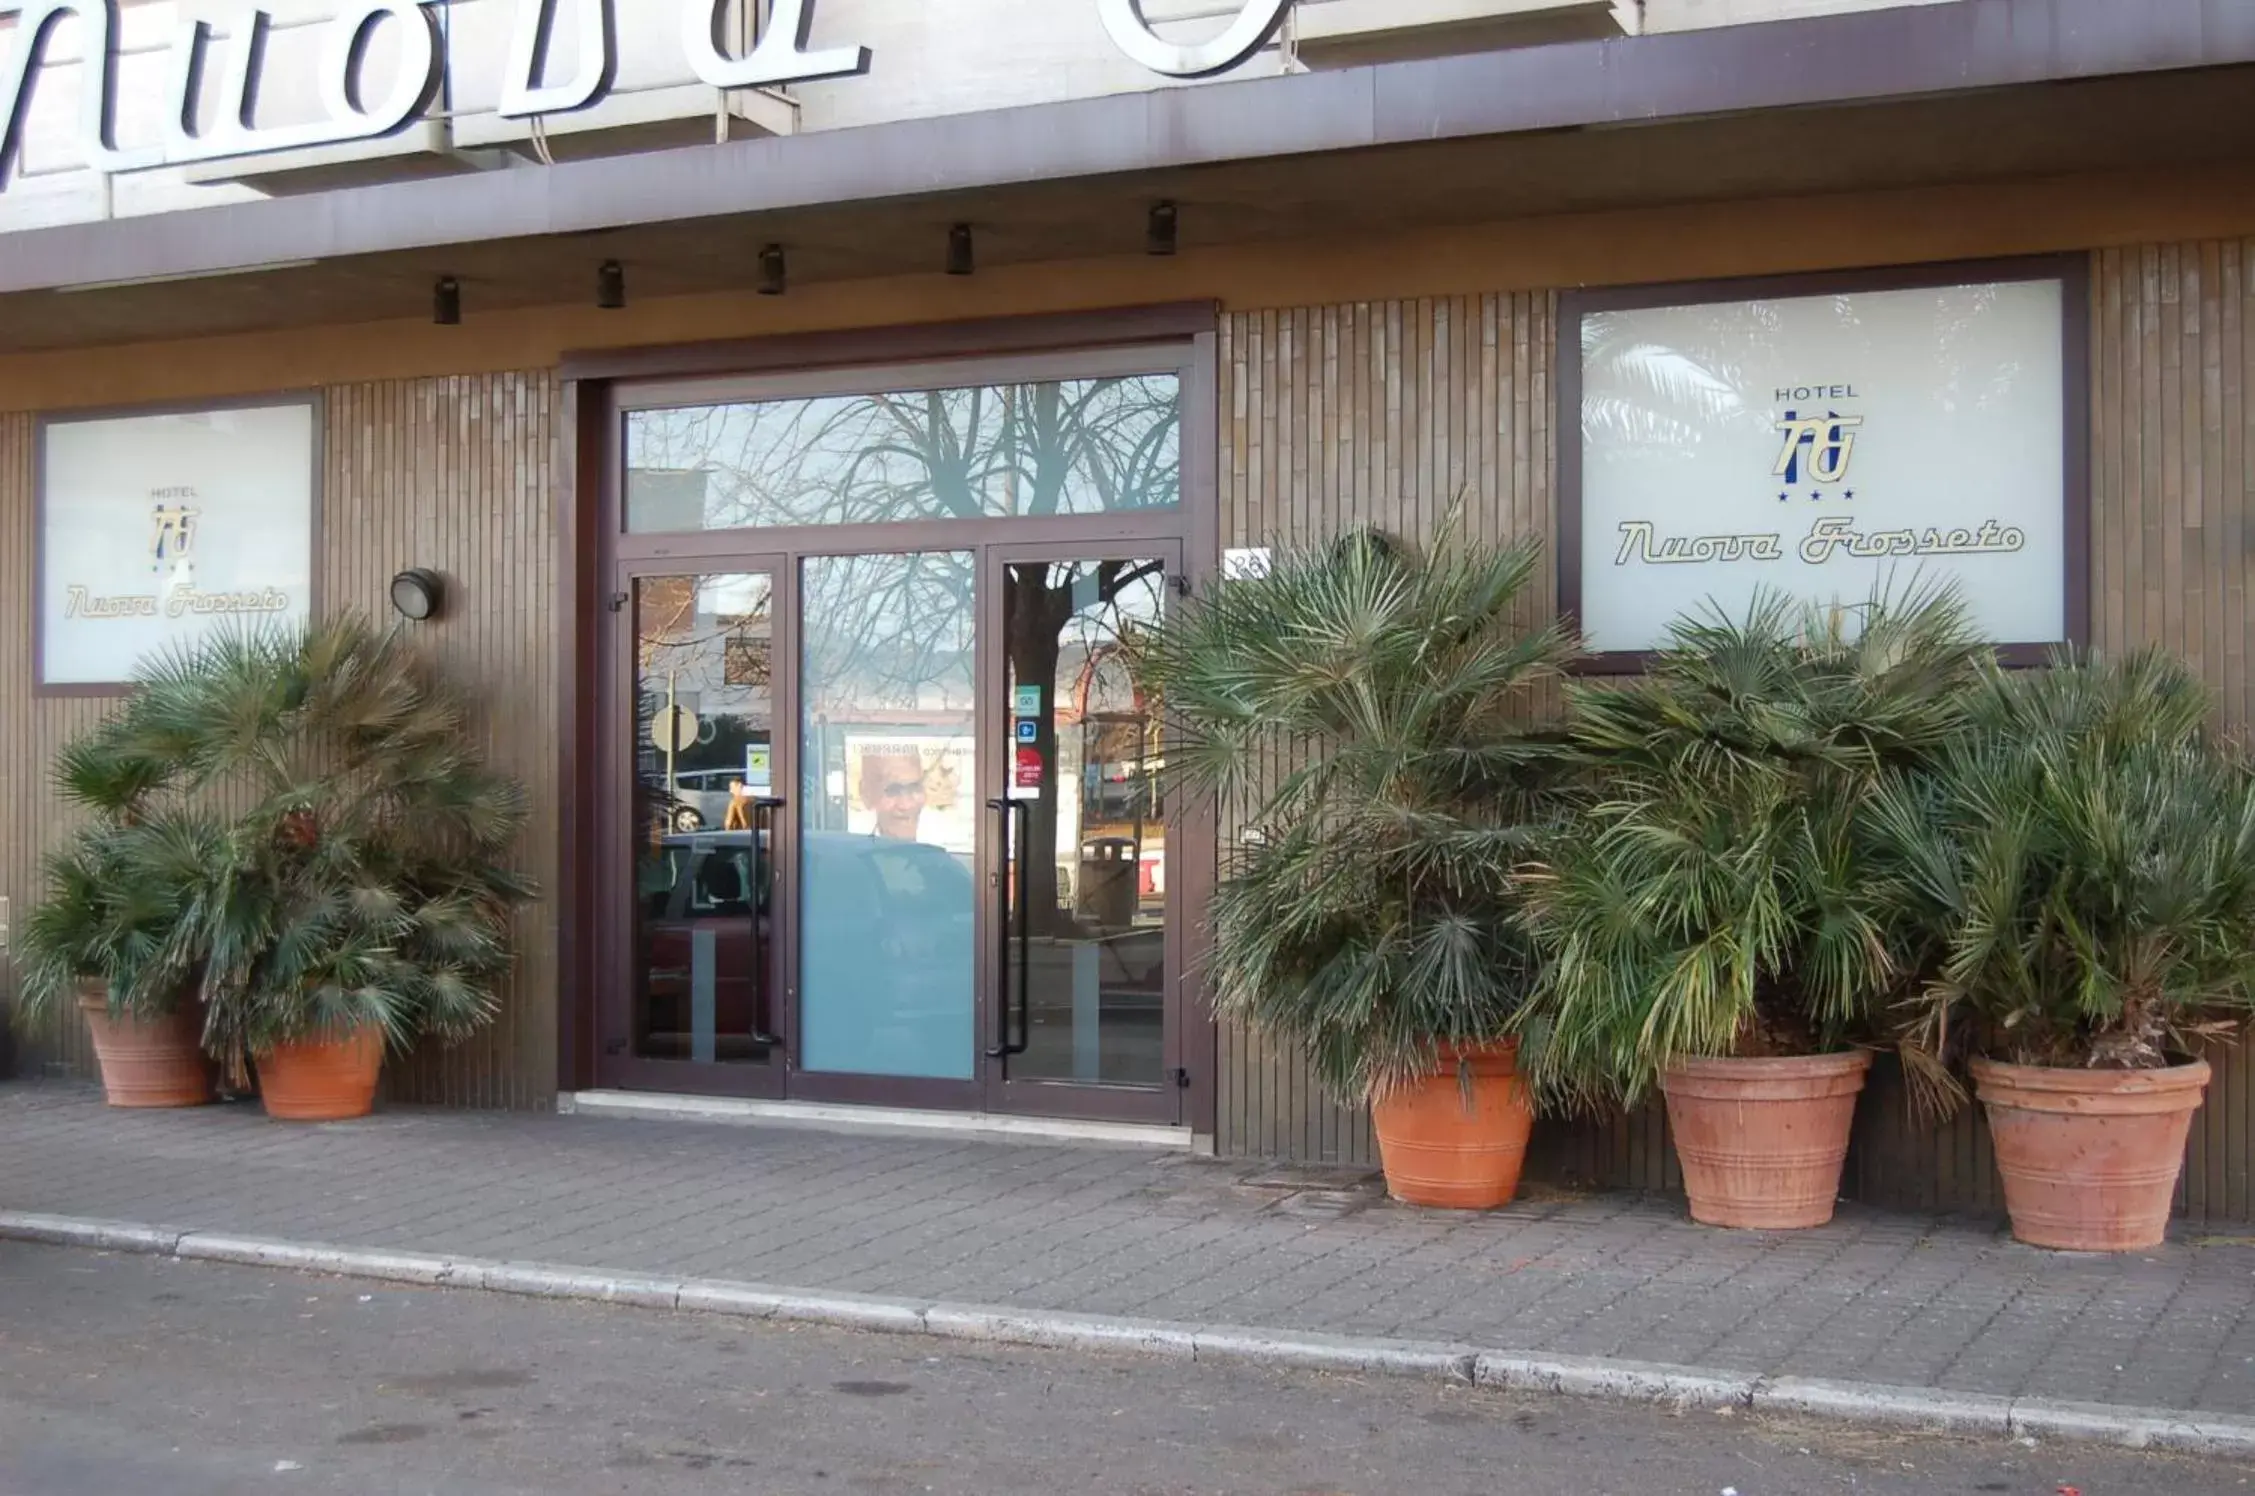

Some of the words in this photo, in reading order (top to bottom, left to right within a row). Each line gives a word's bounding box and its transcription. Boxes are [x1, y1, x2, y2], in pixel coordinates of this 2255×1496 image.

[1775, 384, 1859, 402] HOTEL
[151, 486, 199, 500] HOTEL
[1614, 521, 1783, 566] Nuova
[64, 584, 158, 619] Nuova
